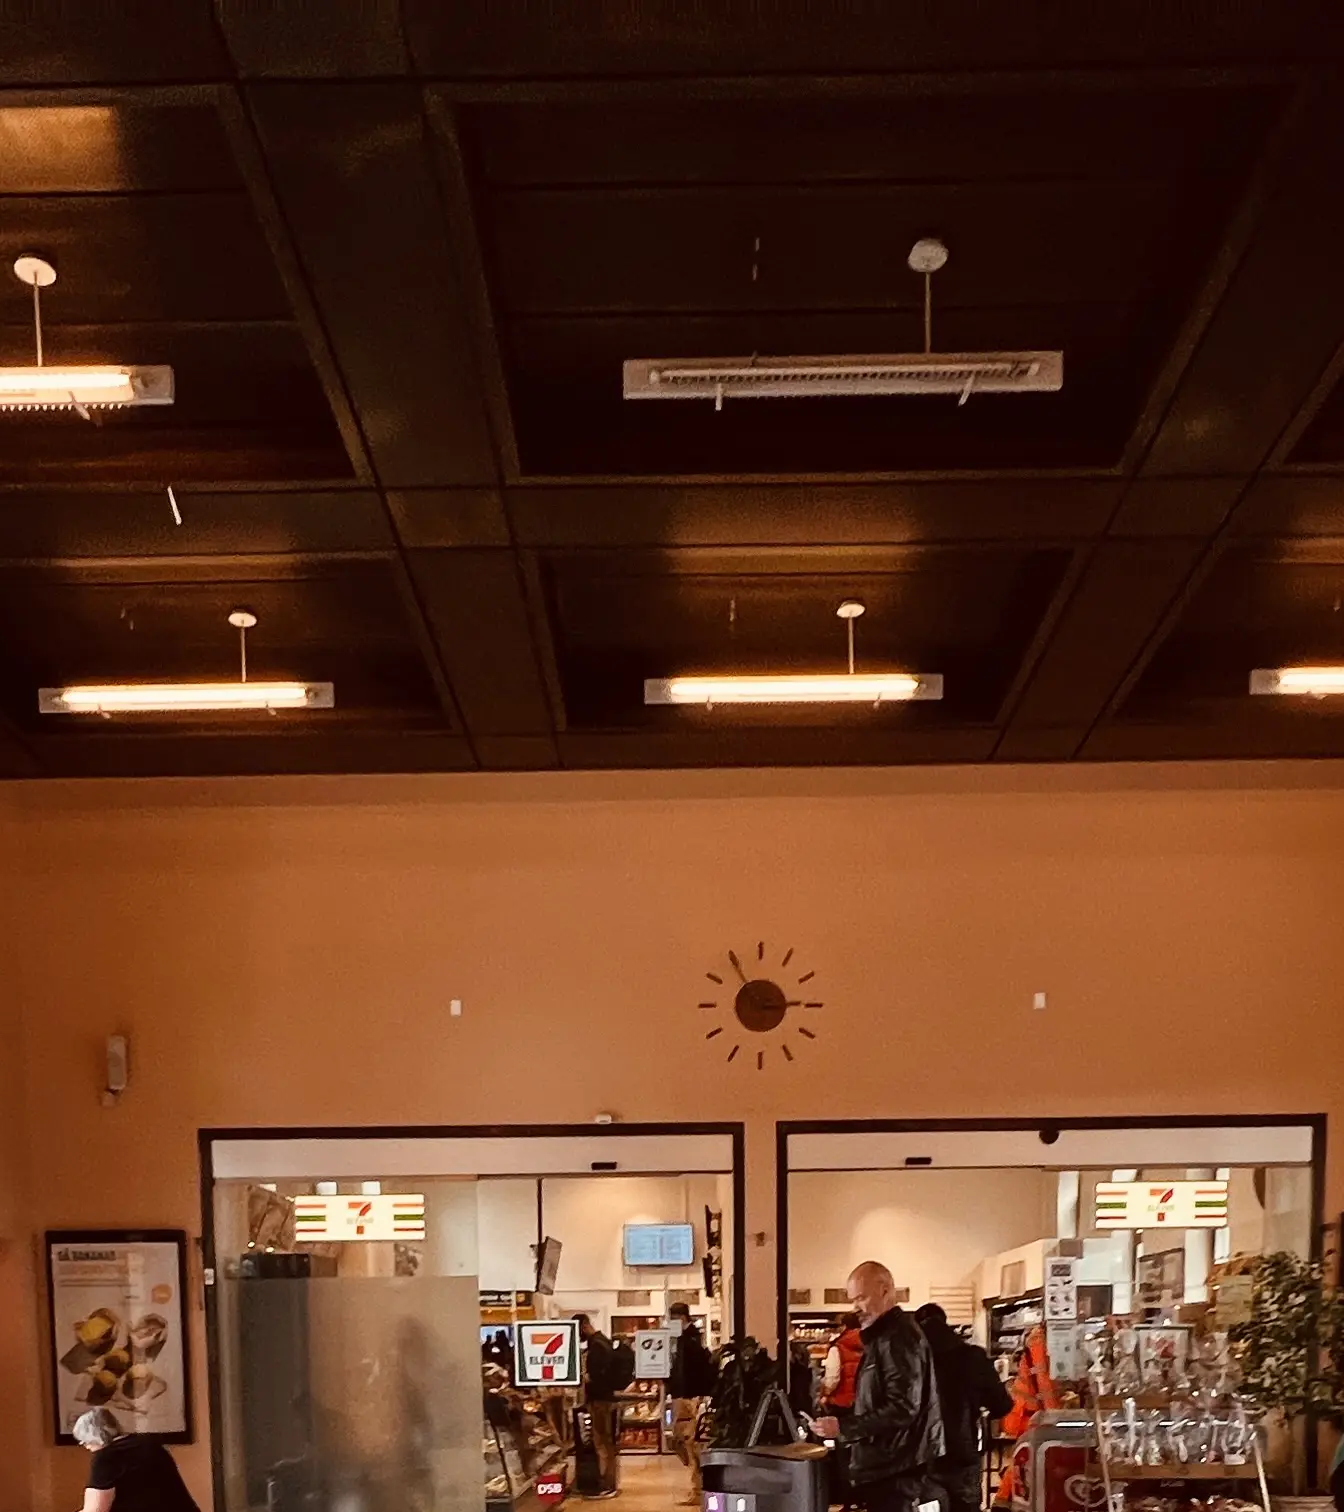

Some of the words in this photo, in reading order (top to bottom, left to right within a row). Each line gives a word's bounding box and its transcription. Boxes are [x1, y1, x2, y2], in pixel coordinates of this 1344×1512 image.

[348, 1202, 372, 1234] 7
[1150, 1188, 1174, 1221] 7
[529, 1355, 565, 1365] ELEVEN
[531, 1333, 564, 1382] 7
[537, 1483, 563, 1495] DSB
